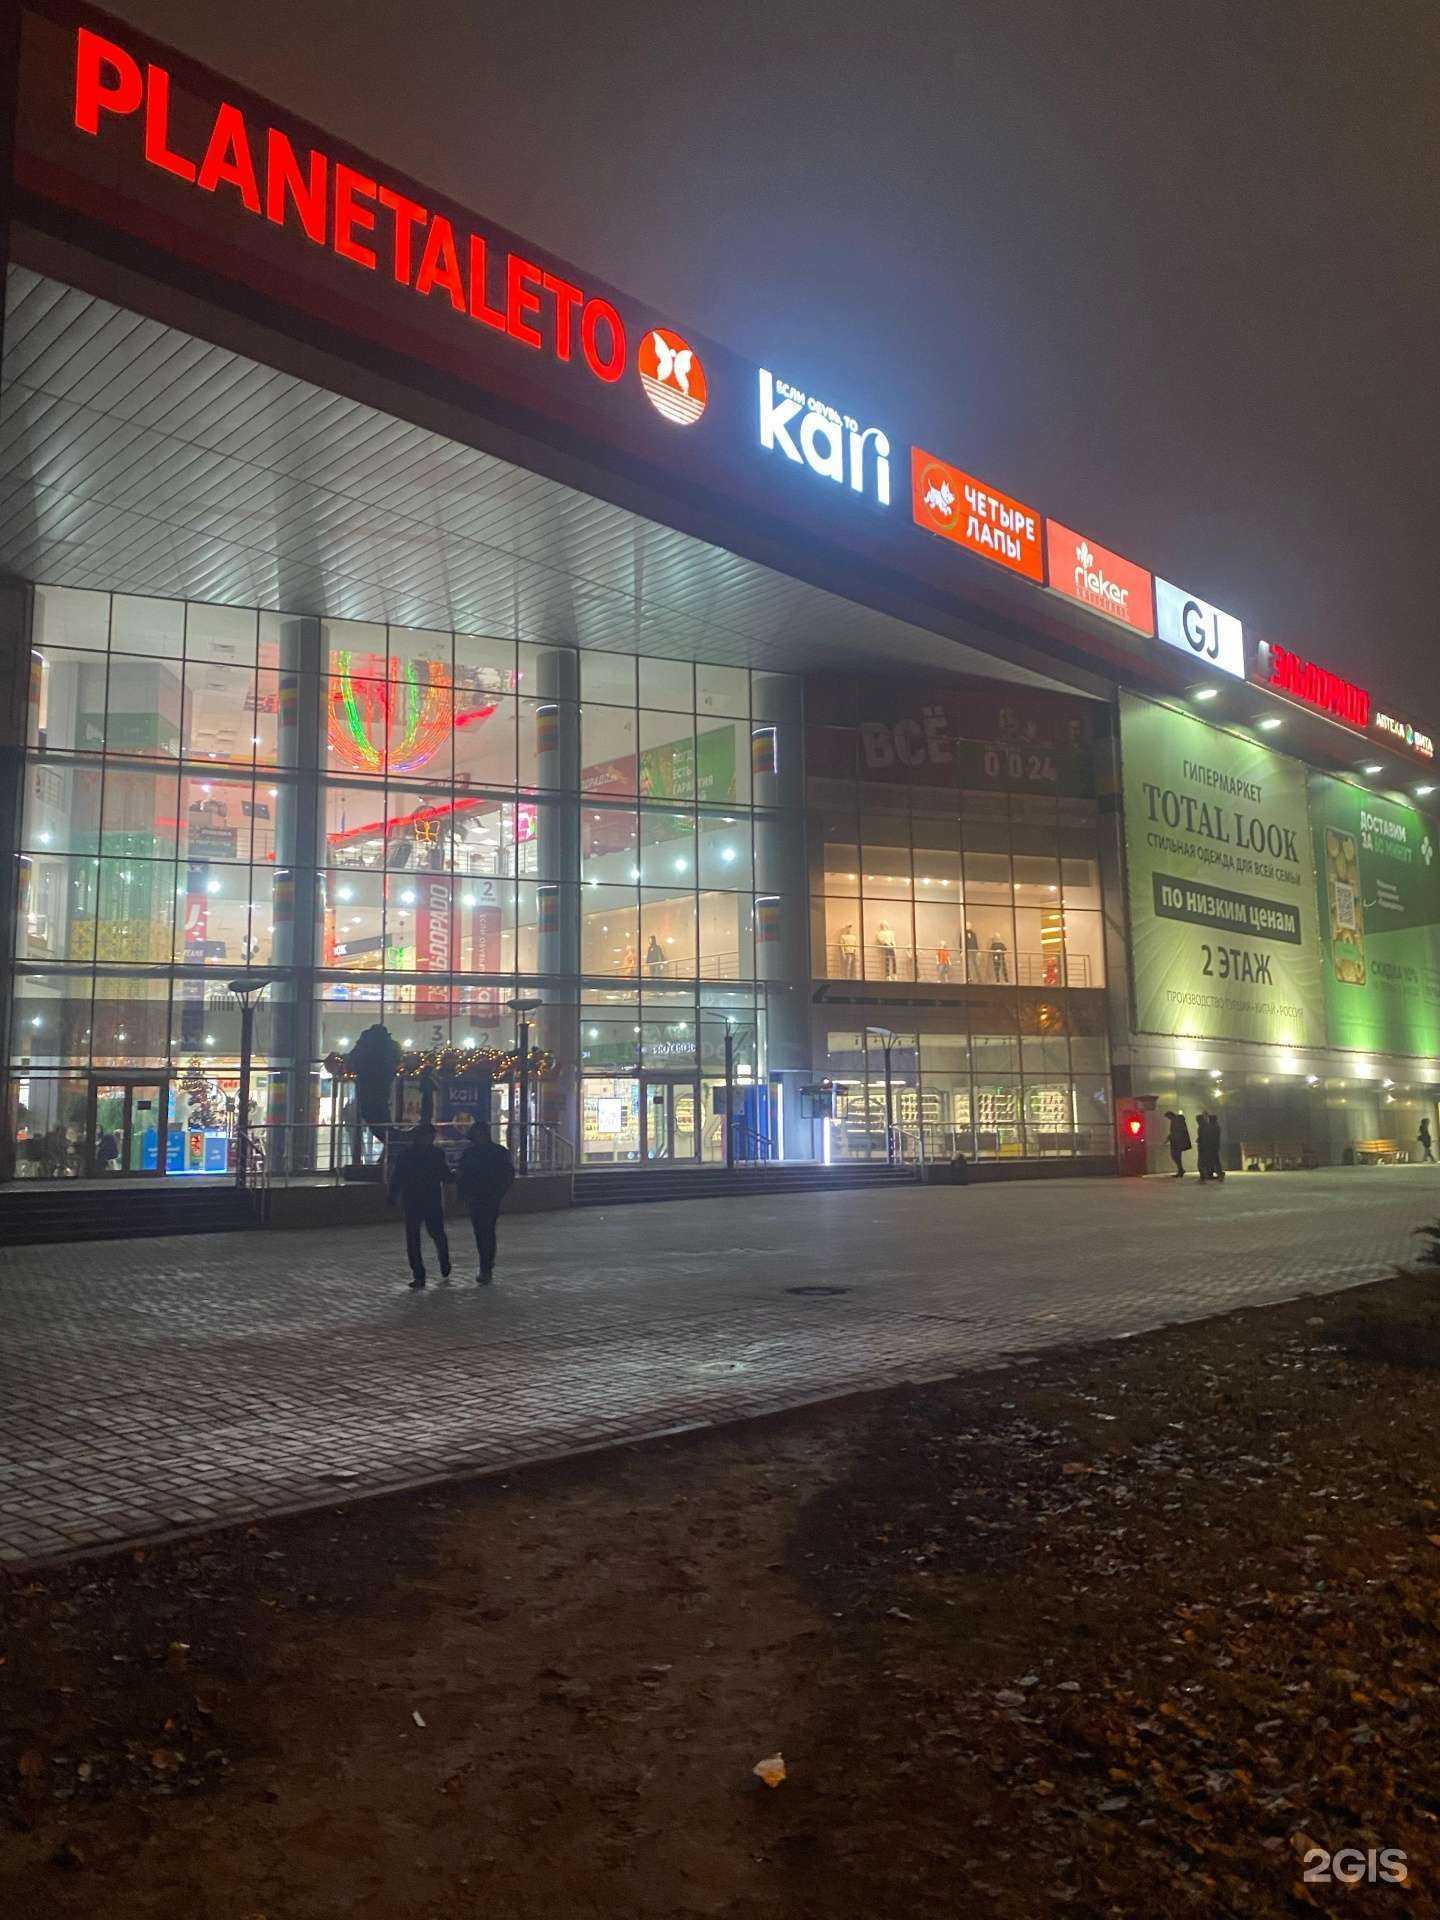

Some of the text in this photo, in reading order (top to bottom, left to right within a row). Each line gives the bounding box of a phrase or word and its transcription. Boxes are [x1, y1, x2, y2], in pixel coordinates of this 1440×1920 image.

[75, 27, 626, 382] PLANETALETO
[759, 367, 890, 506] kari
[964, 485, 1035, 542] ЧЕТЫРЕ
[967, 516, 1021, 561] ЛАПЫ
[1075, 567, 1129, 606] rieker
[1183, 601, 1219, 659] GJ
[860, 704, 955, 769] ВСЁ
[1183, 760, 1262, 803] ГИПЕРМАРКЕТ
[1143, 782, 1299, 863] TOTAL LOOK
[1361, 810, 1407, 843] ДОСТАВИМ
[1147, 833, 1196, 859] СТИЛЬНАЯ
[1197, 846, 1234, 871] ОДЕЖДА
[1236, 857, 1253, 874] ДЛЯ
[1254, 862, 1275, 880] ВСЕЙ
[1250, 907, 1295, 933] ценам
[1201, 944, 1273, 986] 2 ЭТАЖ
[1166, 990, 1224, 1009] ПРОИЗВОДСТВО
